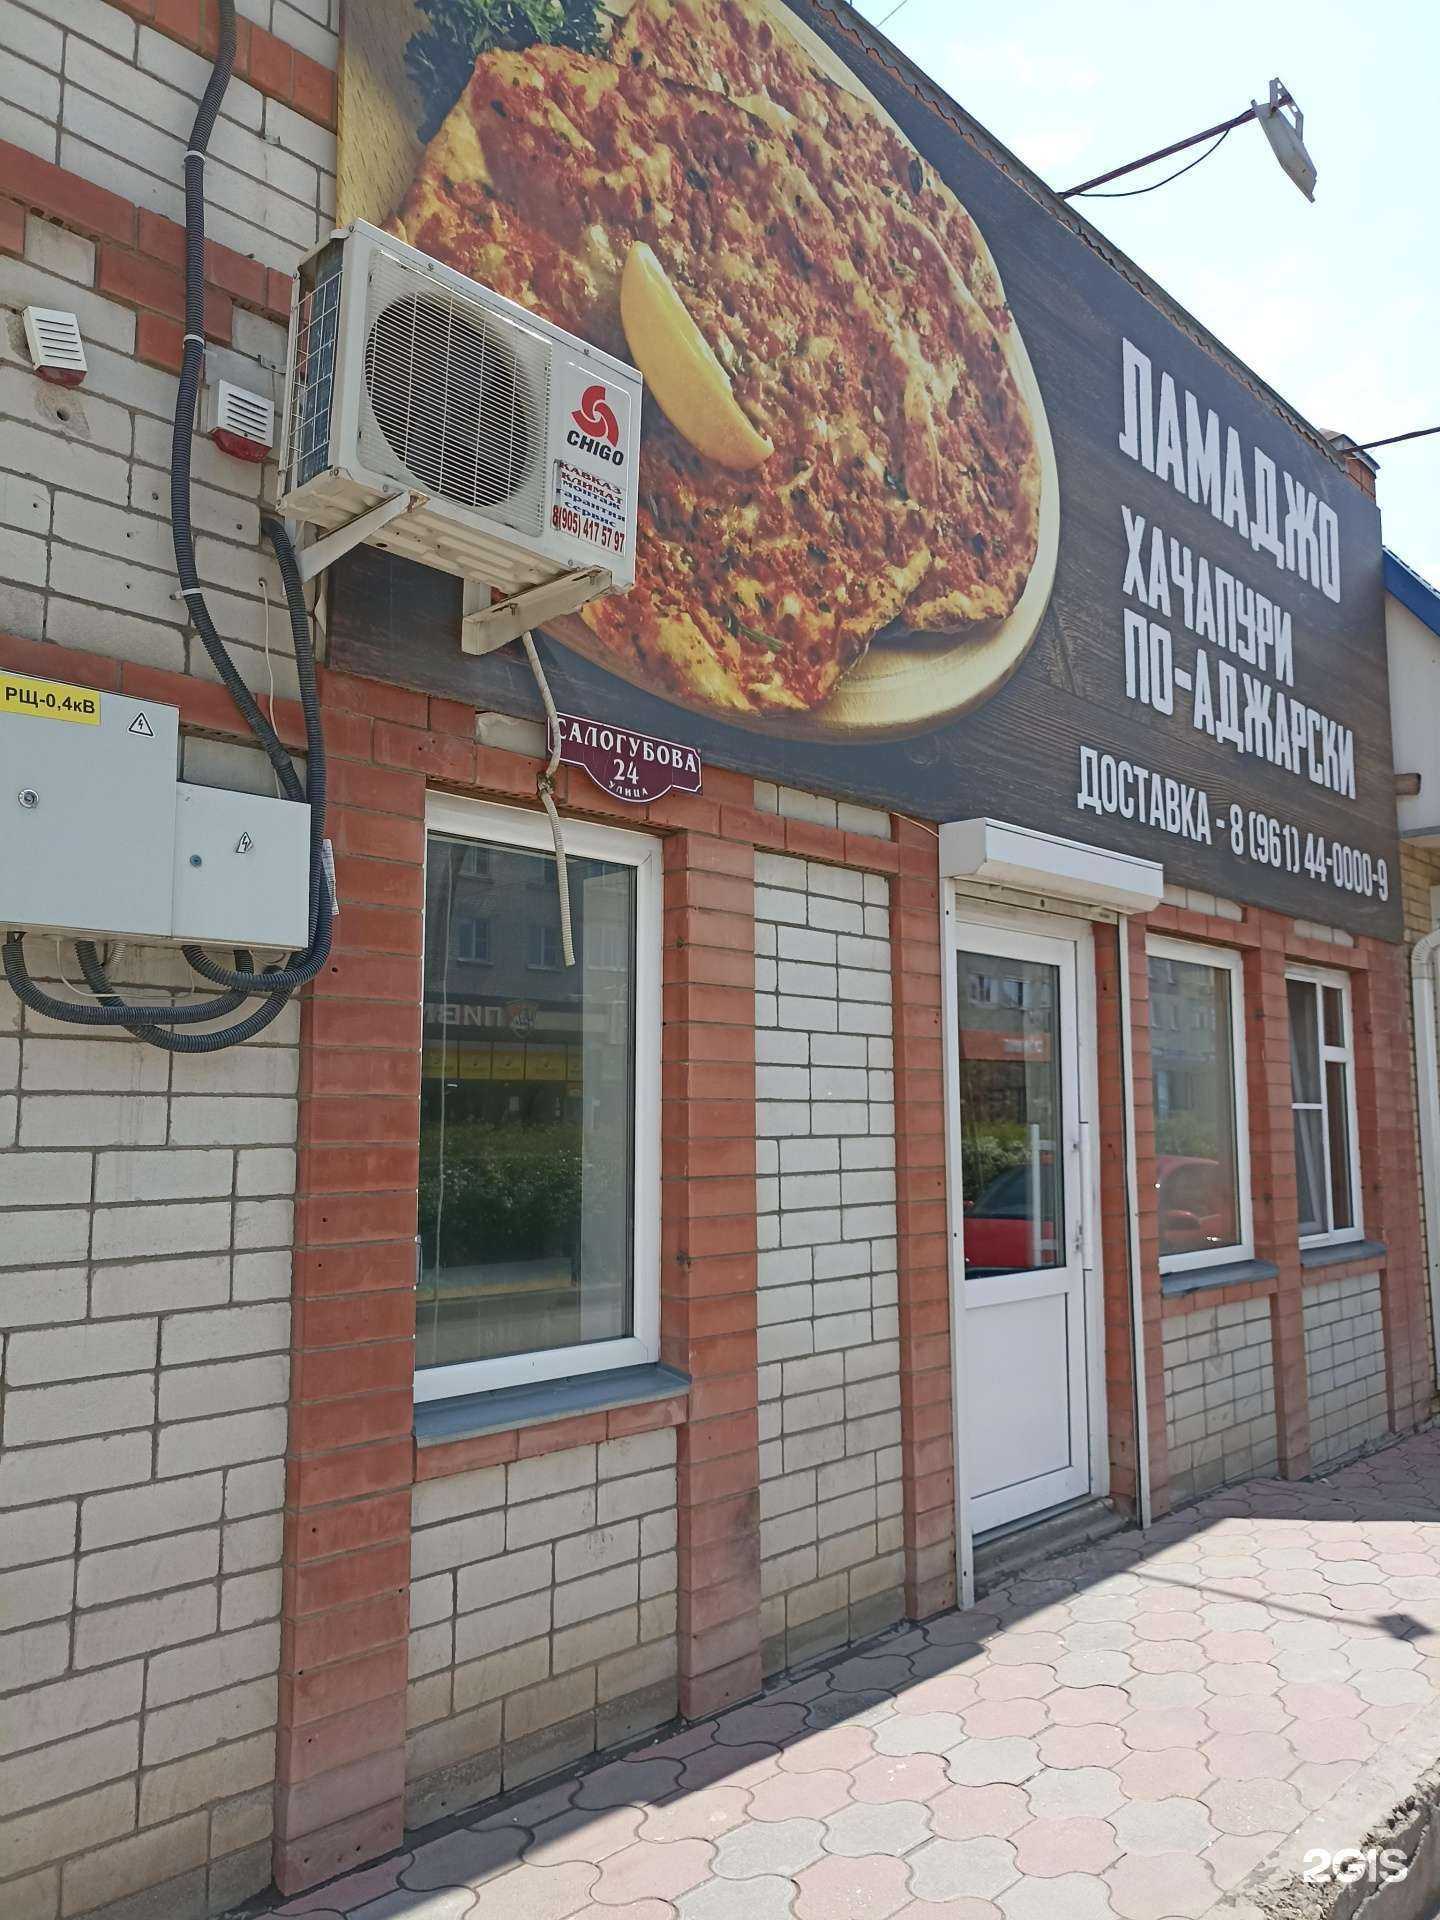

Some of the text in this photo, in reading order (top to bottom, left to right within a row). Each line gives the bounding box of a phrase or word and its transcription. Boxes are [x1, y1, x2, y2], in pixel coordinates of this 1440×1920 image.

[567, 430, 624, 466] CHIGO
[1119, 337, 1341, 604] ЛАМАДЖО
[560, 460, 622, 494] КАВКАЗ
[552, 505, 625, 552] 8(905) 417 57 97
[1121, 505, 1294, 687] ХАЧАПУРИ
[5, 686, 95, 714] РЩ-0,4кВ
[1124, 608, 1356, 799] ПО-АДЖАРСКИ
[557, 718, 697, 773] САЛОГУБОВА
[608, 780, 649, 798] УЛИЦА
[613, 759, 639, 784] 24
[1078, 745, 1212, 845] ДОСТАВКА
[1230, 803, 1244, 855] 8
[1249, 811, 1300, 874] (961)
[1304, 832, 1388, 901] 44-0000-9
